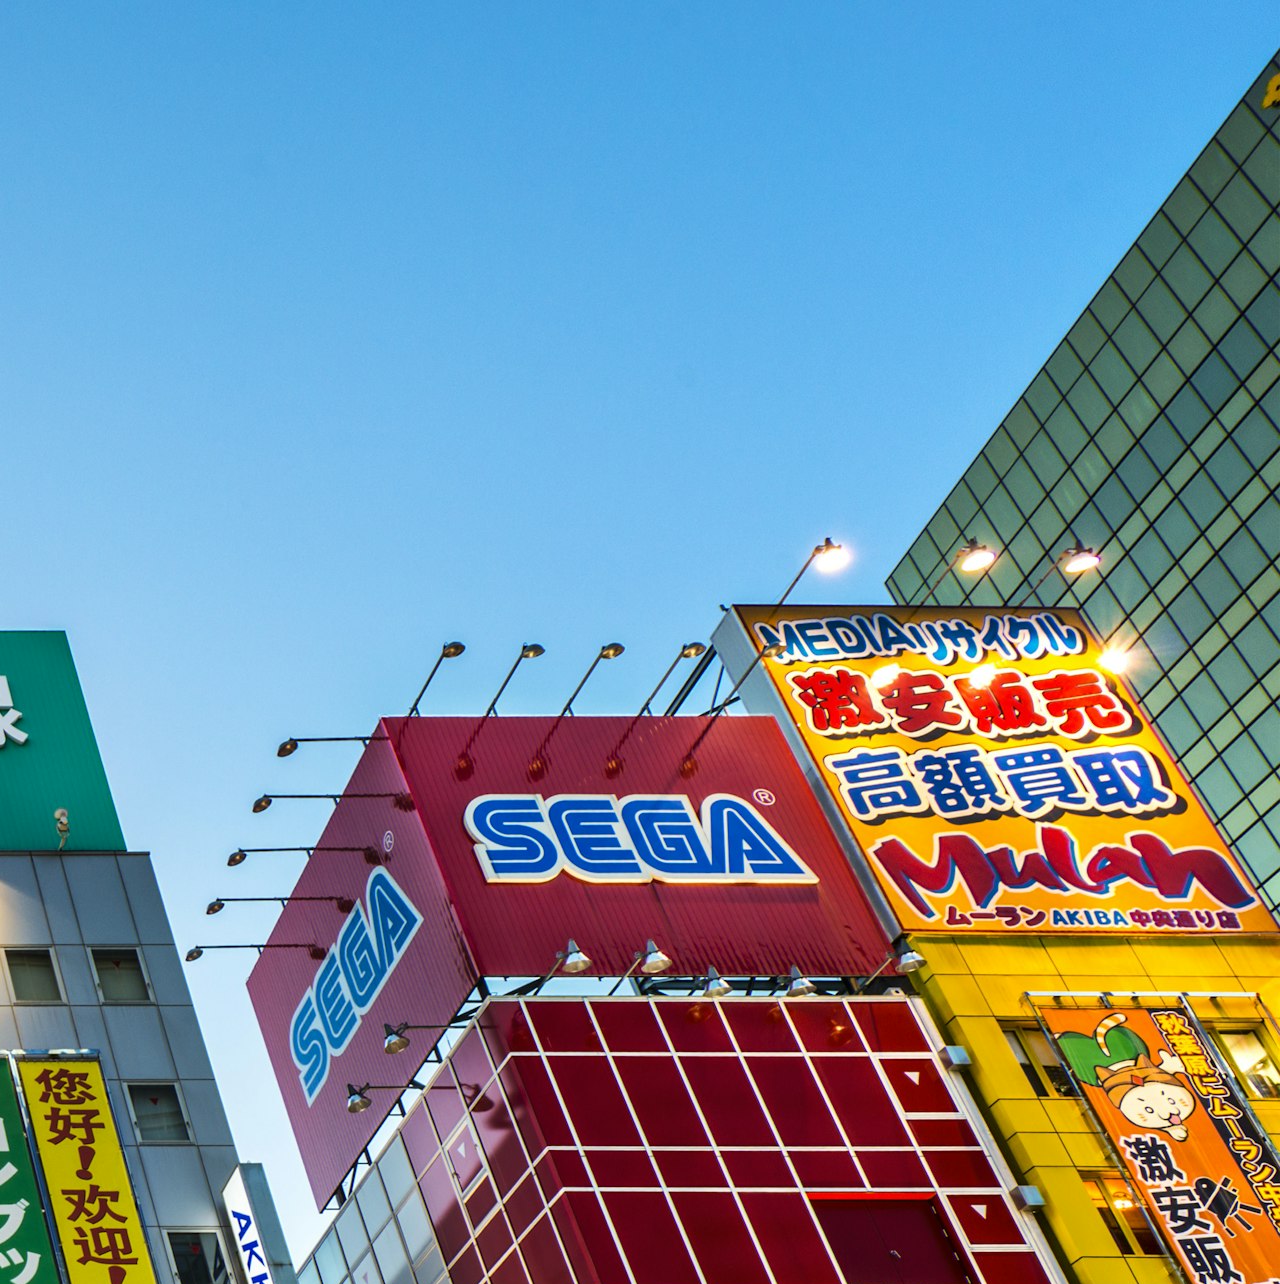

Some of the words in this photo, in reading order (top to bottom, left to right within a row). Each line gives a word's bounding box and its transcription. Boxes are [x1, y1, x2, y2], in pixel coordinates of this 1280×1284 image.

[792, 668, 1130, 736] 激安販売
[830, 749, 1172, 816] 高額買取
[467, 795, 817, 883] SEGA
[870, 826, 1256, 922] Mulan
[945, 906, 1047, 928] ムーラン
[1052, 909, 1128, 928] AKIBA
[1131, 909, 1241, 930] 中央通り店
[290, 866, 423, 1106] SEGA
